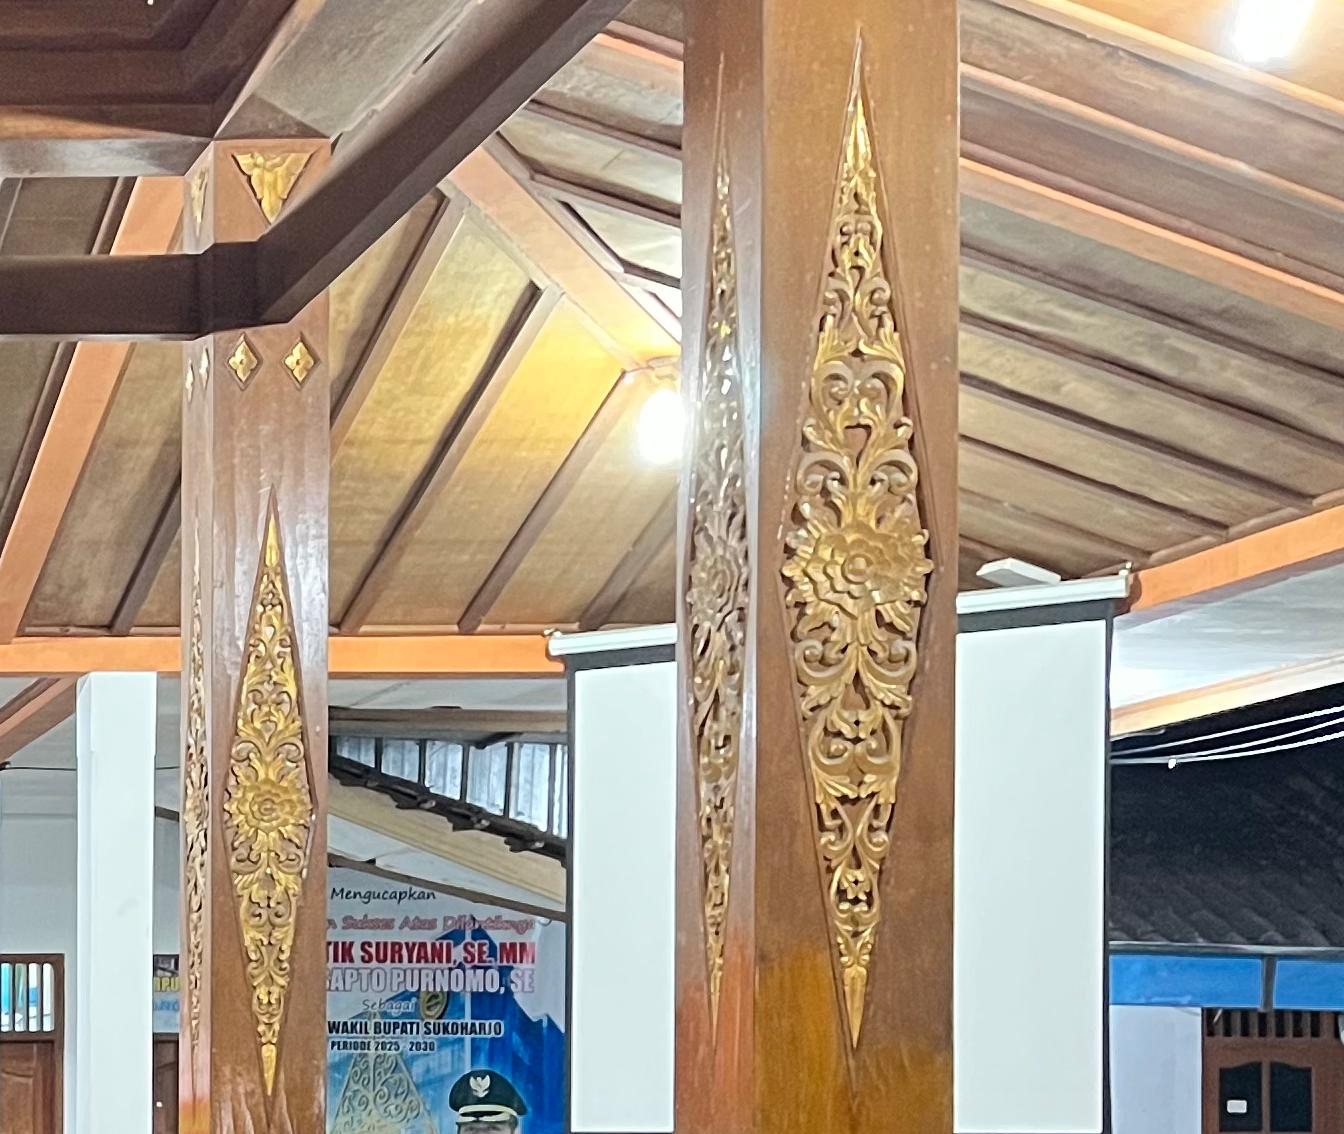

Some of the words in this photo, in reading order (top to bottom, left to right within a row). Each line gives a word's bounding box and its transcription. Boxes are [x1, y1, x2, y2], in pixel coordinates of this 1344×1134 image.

[331, 886, 436, 905] Mengucapkan
[360, 941, 457, 966] SURYANI,
[499, 941, 536, 964] MM
[391, 967, 506, 995] PURNOMO,
[510, 967, 535, 993] SE
[362, 998, 416, 1017] Sebagai
[328, 1020, 370, 1036] WAKIL
[373, 1021, 420, 1036] BUPATI
[423, 1021, 502, 1036] SUKOHARJO
[331, 1040, 372, 1051] PERIODE
[374, 1040, 401, 1051] 2025
[408, 1041, 435, 1051] 2030
